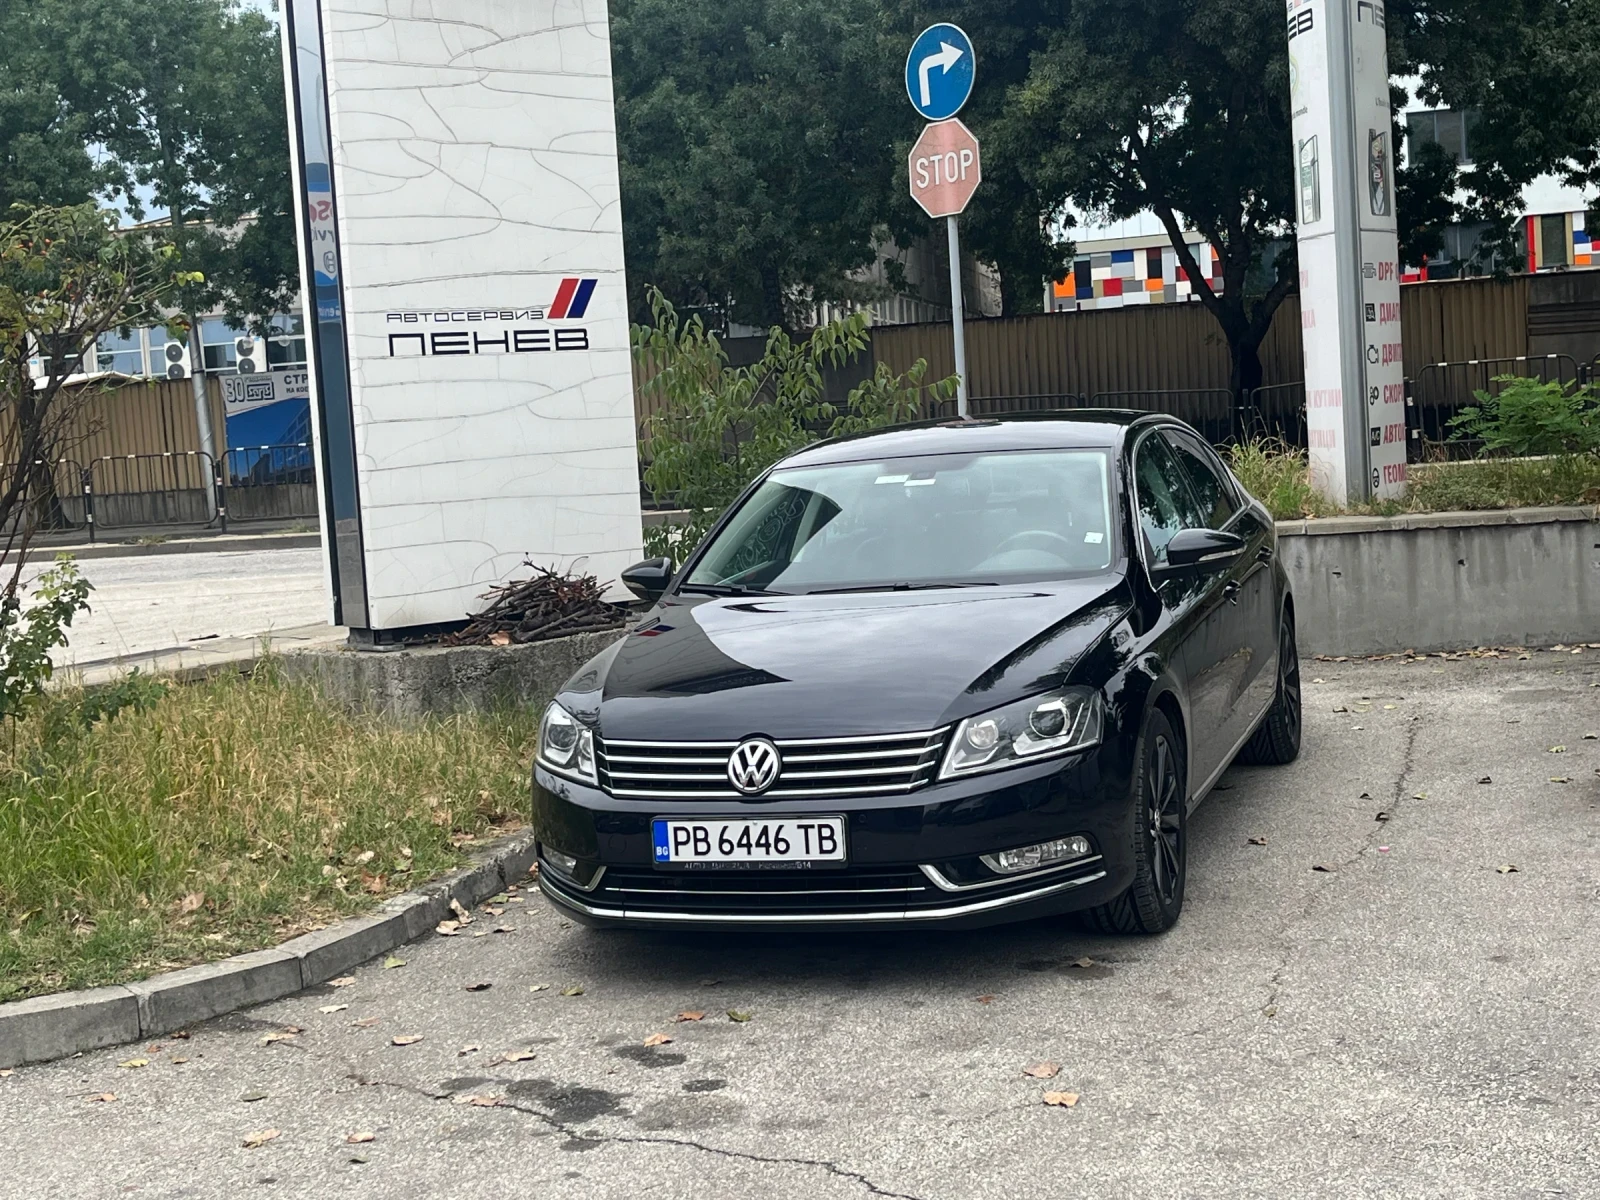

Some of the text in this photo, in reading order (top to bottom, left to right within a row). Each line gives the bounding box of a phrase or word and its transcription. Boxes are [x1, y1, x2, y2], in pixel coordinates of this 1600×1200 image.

[916, 149, 974, 189] STOP
[386, 311, 544, 323] АВТОСЕРВИЗ
[388, 328, 589, 357] ПЕНЕВ
[225, 378, 245, 403] 30
[284, 374, 308, 385] СТР
[656, 846, 669, 856] BG
[673, 823, 838, 856] PB 6446 TB
